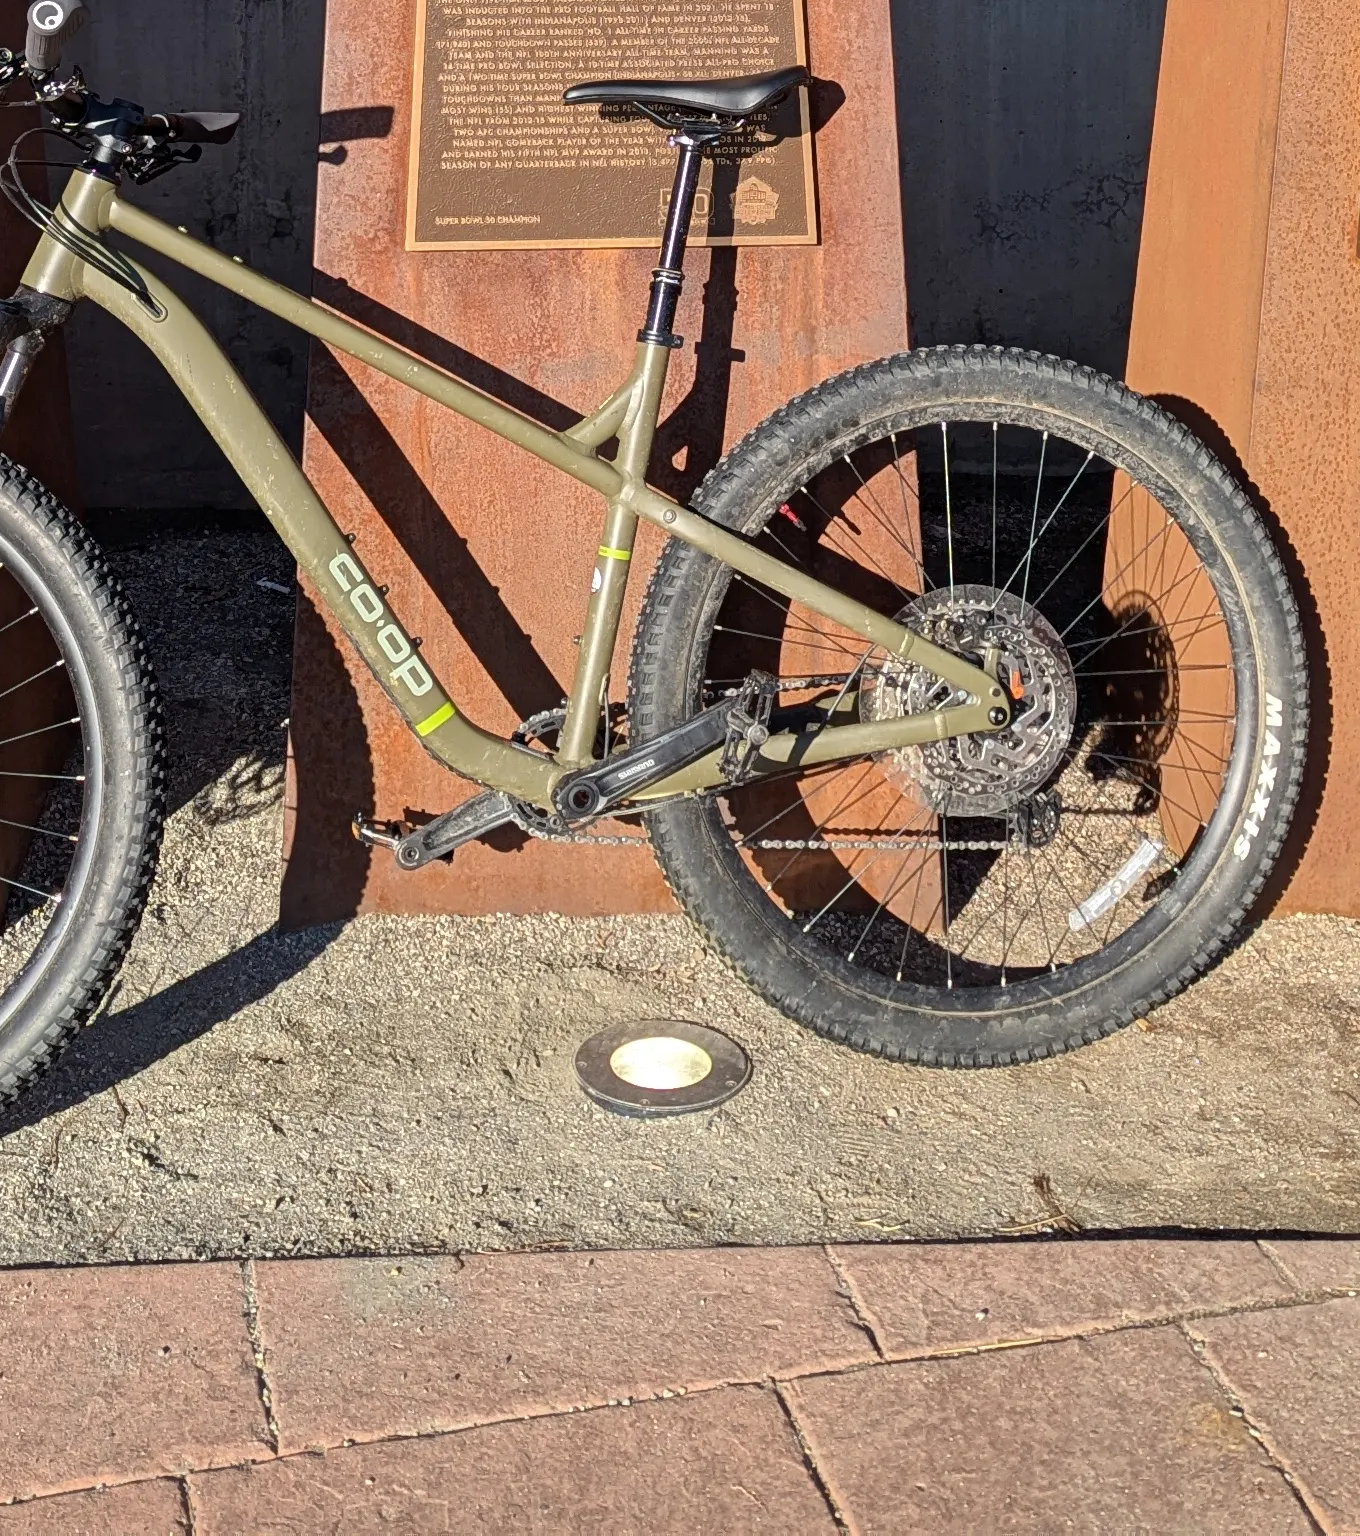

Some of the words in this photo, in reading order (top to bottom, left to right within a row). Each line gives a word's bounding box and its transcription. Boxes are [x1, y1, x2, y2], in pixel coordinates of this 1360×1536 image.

[435, 216, 459, 225] SUPER
[460, 216, 484, 225] BOWL
[497, 214, 541, 224] CHAMPION
[1233, 692, 1283, 862] MAXXIS
